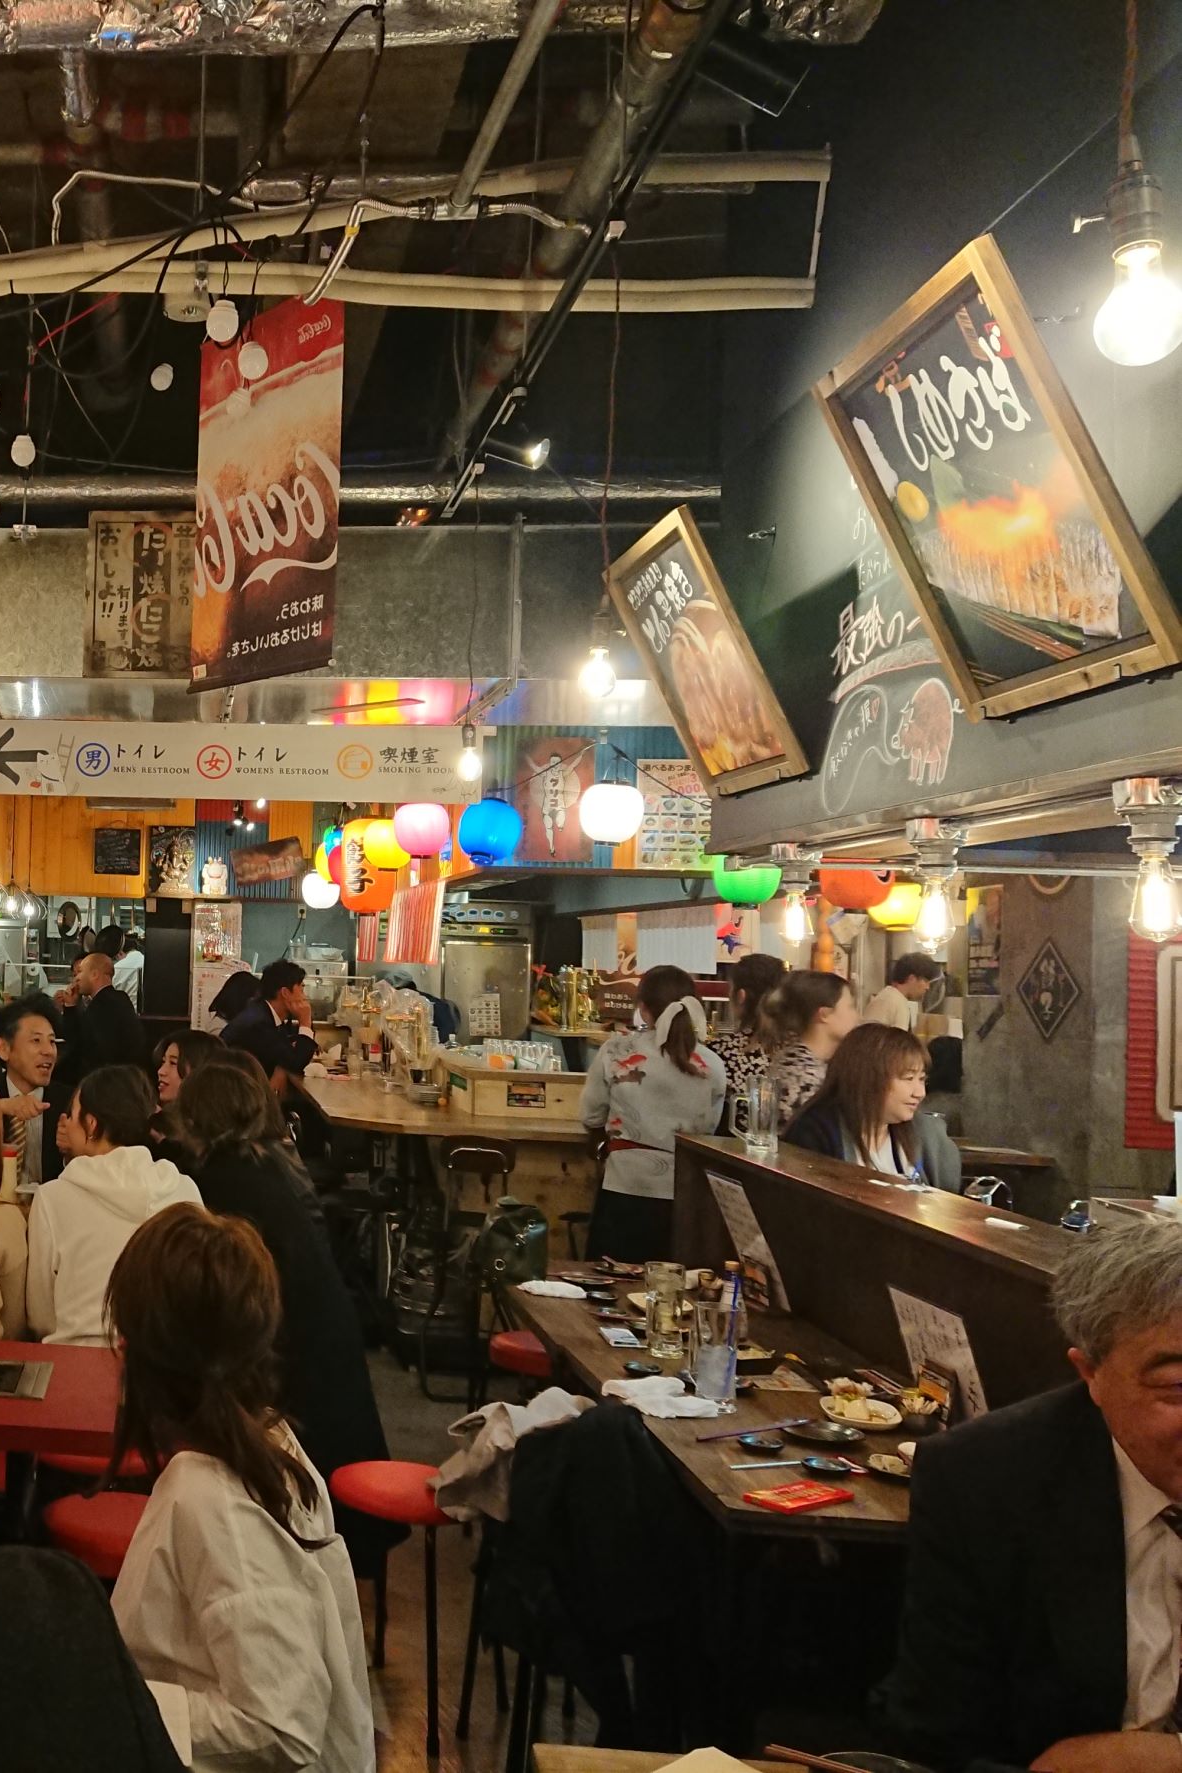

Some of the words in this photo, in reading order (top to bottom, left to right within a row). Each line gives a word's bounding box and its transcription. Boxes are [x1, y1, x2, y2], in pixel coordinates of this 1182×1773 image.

[885, 325, 1031, 472] しめさば
[85, 749, 102, 770] 男
[116, 743, 166, 759] トイレ
[204, 752, 225, 772] 女
[237, 746, 288, 762] トイレ
[379, 746, 440, 765] 喫煙室
[141, 766, 190, 775] RESTROOM
[378, 766, 421, 774] SMOKING
